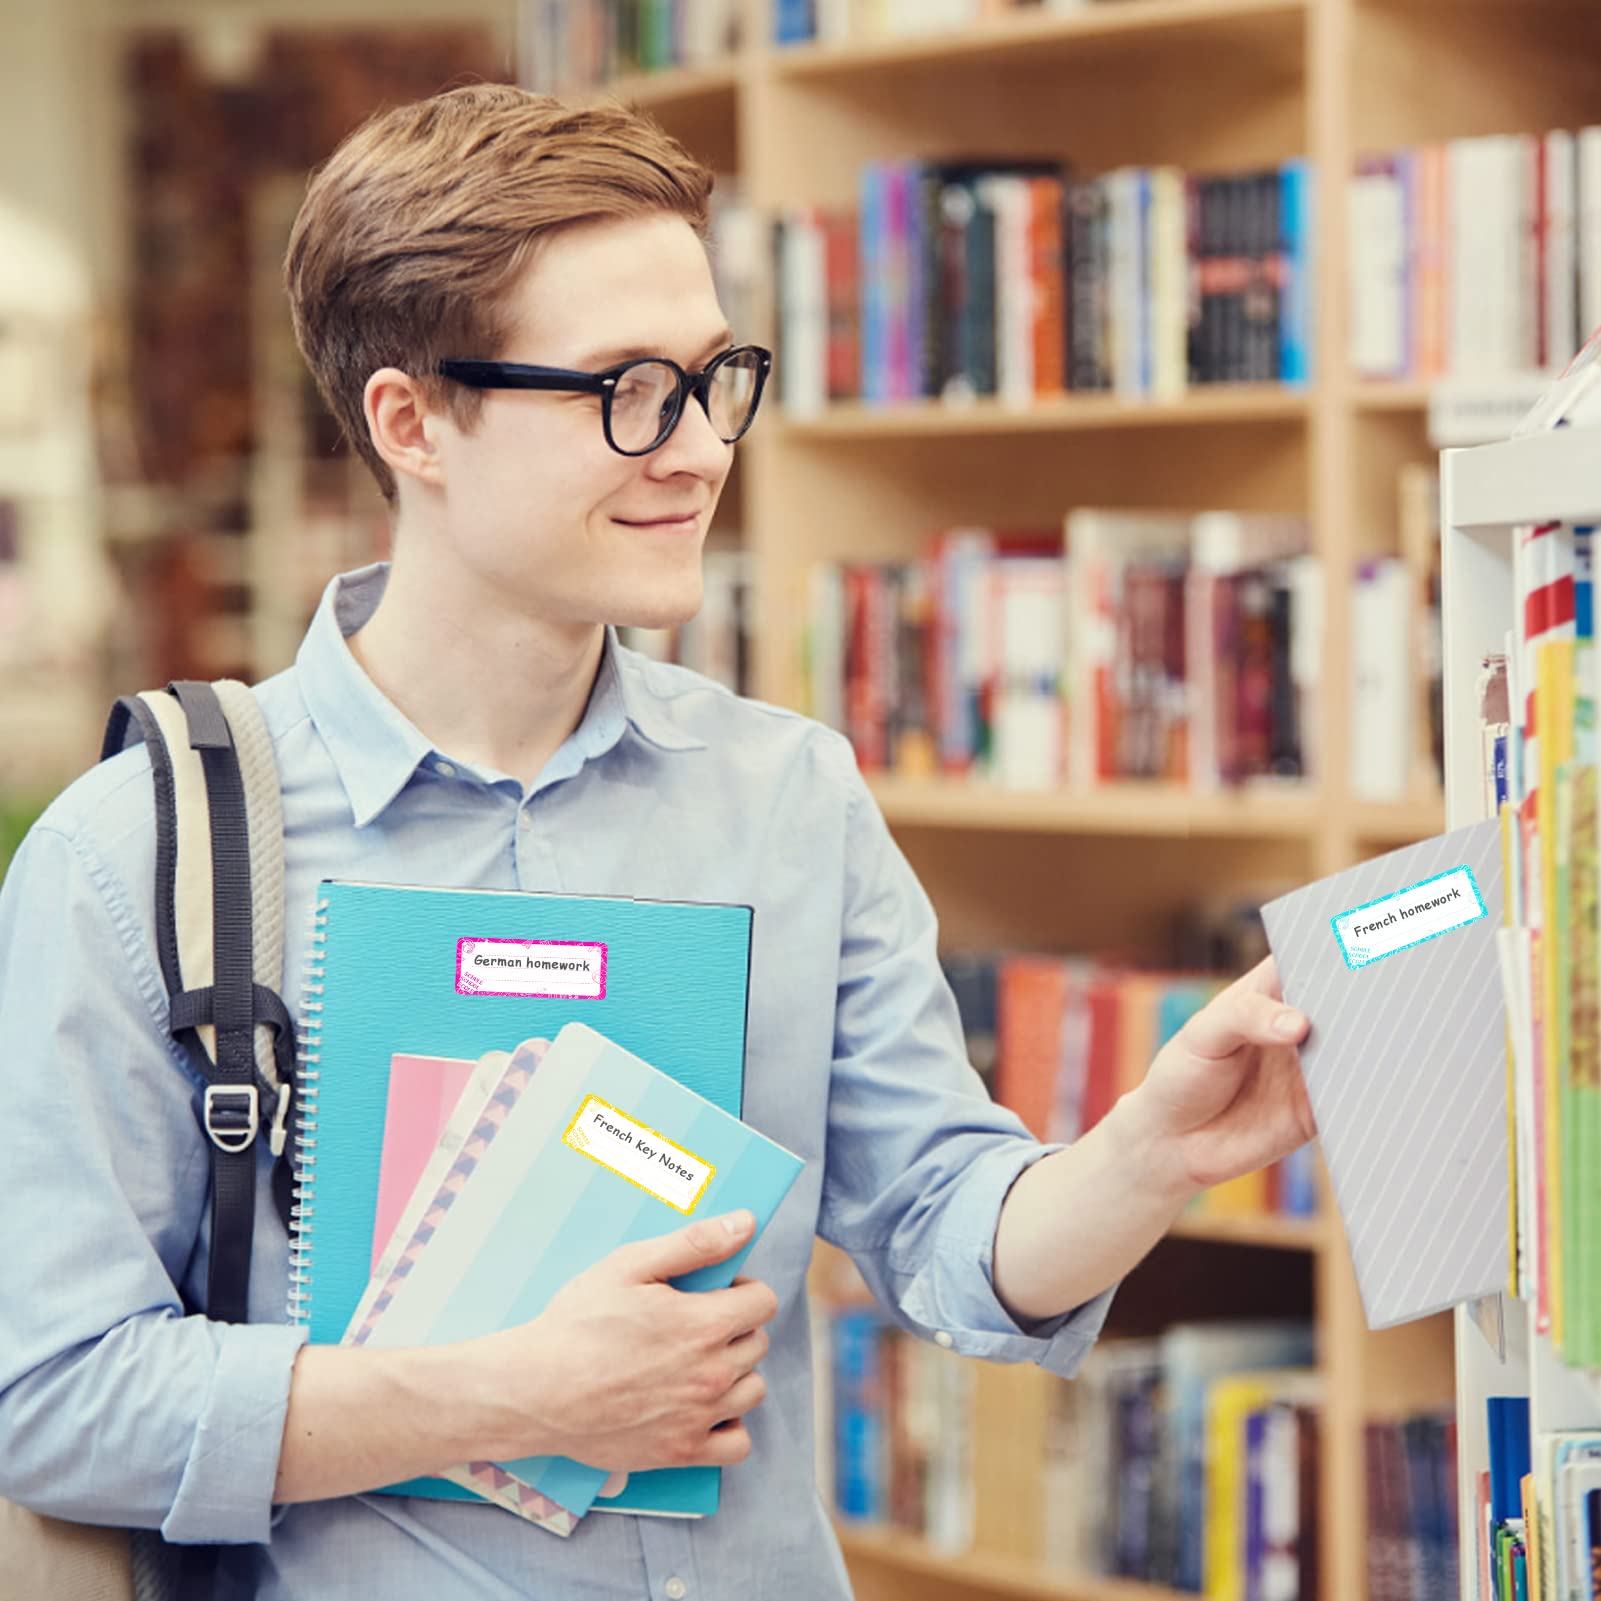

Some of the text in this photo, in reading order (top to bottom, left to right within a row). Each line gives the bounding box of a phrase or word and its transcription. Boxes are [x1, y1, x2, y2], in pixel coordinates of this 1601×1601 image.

[1353, 888, 1461, 938] French homework
[474, 955, 591, 971] German homework
[593, 1113, 633, 1144] French
[635, 1139, 658, 1160] Key
[658, 1153, 695, 1182] Notes
